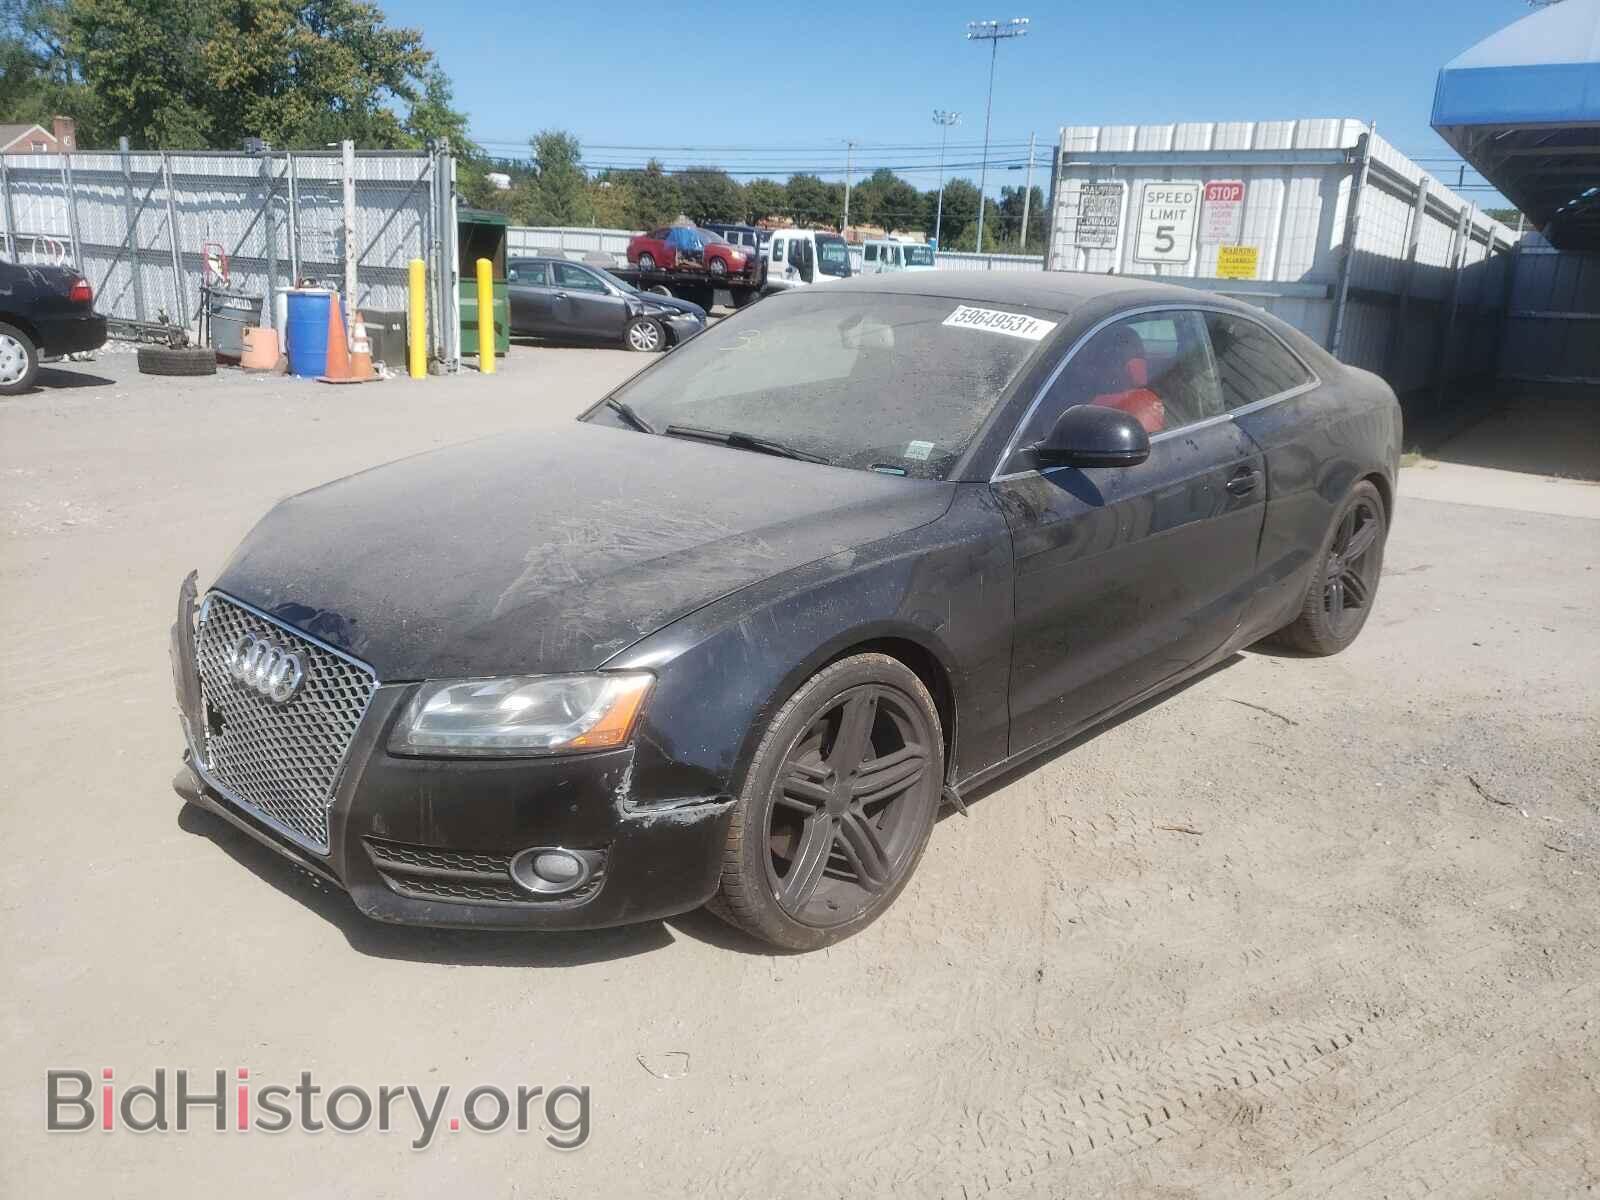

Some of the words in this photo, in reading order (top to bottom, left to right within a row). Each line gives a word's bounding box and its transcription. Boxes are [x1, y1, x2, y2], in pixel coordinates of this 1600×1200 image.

[1147, 192, 1193, 203] SPEED
[1208, 186, 1240, 200] STOP
[1150, 208, 1187, 221] LIMIT
[1154, 225, 1175, 253] 5
